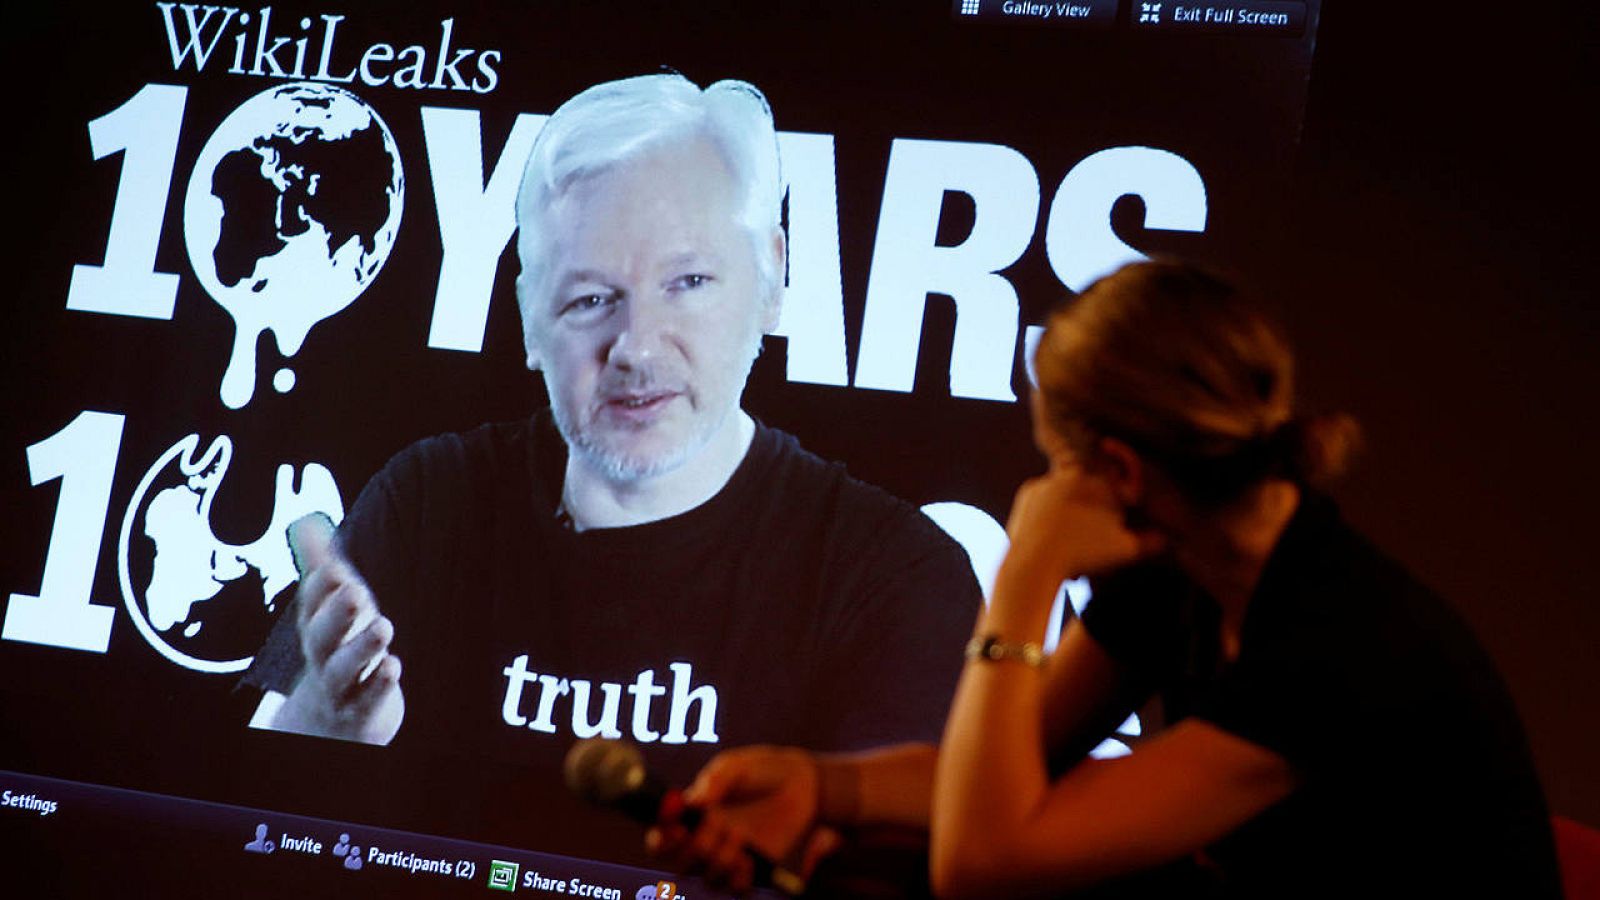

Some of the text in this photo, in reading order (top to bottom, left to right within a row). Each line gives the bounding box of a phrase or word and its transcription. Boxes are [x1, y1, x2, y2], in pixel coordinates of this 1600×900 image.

[1003, 0, 1091, 18] Gallery View
[1174, 6, 1288, 25] Exit Full Screen
[157, 2, 501, 93] WikiLeaks
[503, 655, 720, 745] truth
[1, 790, 58, 815] Settings
[280, 833, 323, 854] Invite
[367, 846, 476, 880] Participants (2)
[523, 870, 622, 900] Share Screen
[659, 883, 671, 899] 2
